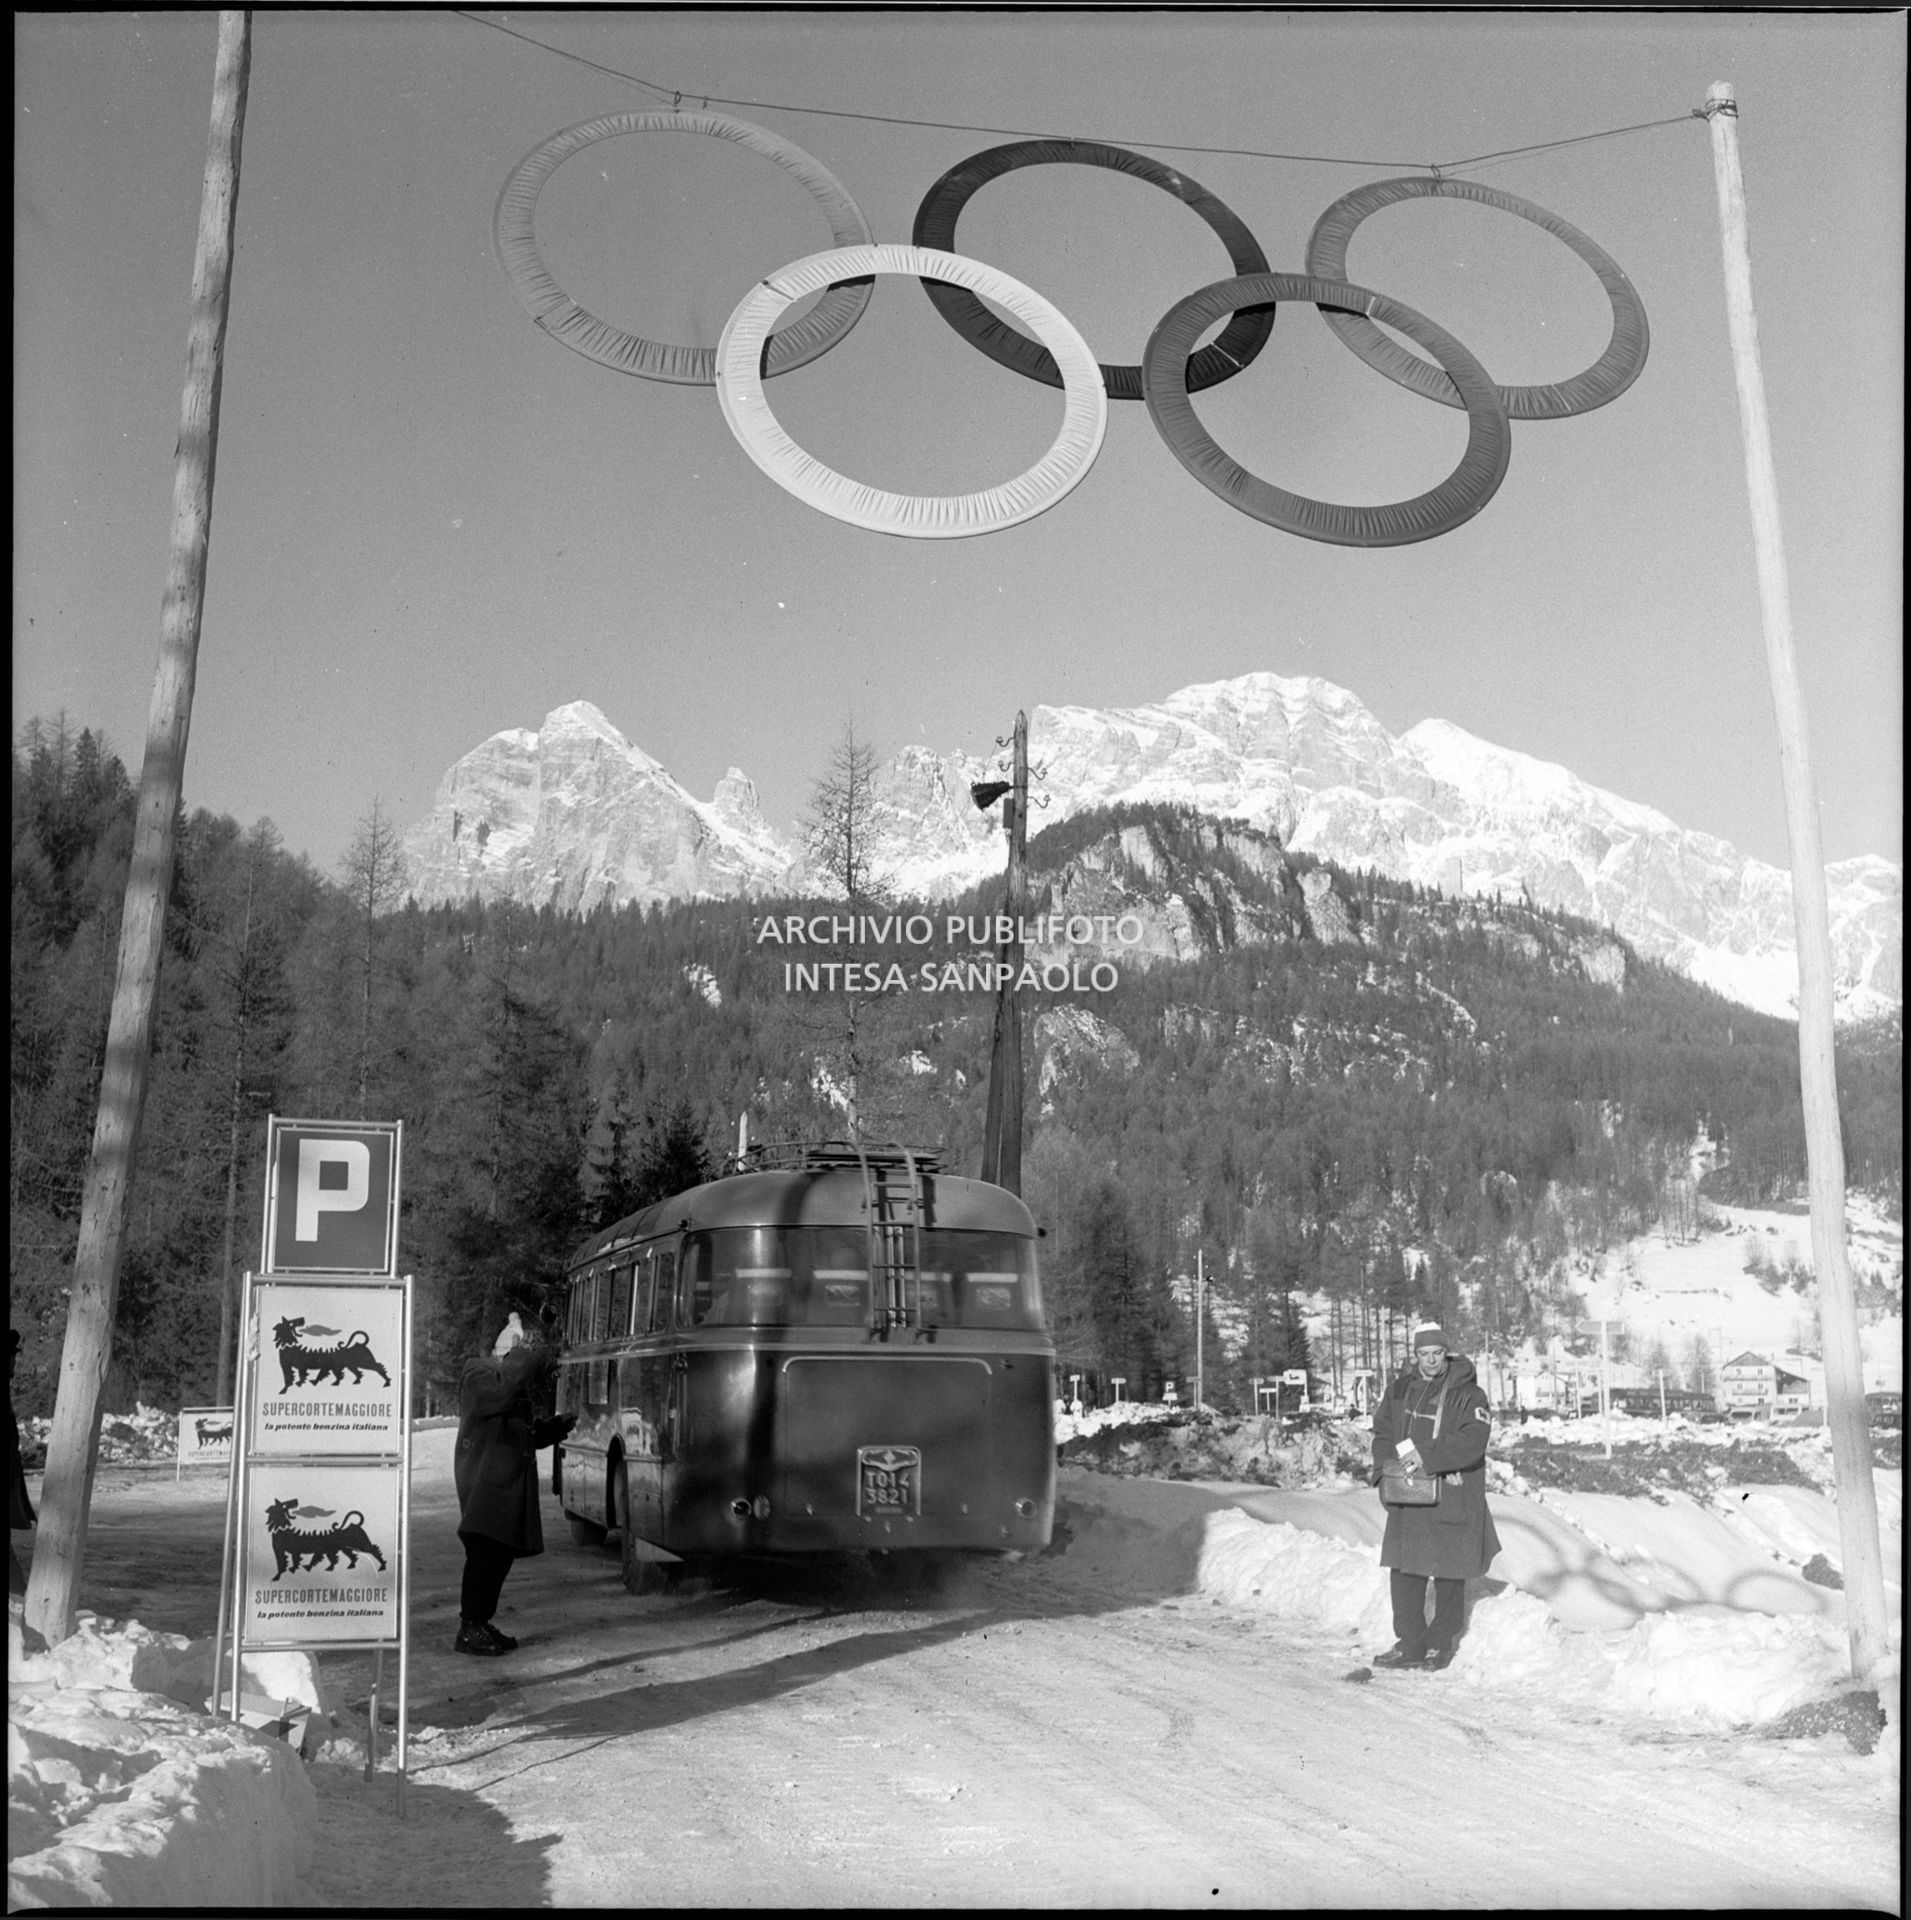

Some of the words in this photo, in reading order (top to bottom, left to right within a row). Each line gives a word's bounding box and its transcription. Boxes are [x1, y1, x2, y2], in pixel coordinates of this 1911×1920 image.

[296, 1139, 370, 1242] P
[1165, 1381, 1174, 1393] P
[262, 1402, 392, 1418] SUPERCORTEMAGGIORE
[264, 1423, 274, 1431] la
[275, 1423, 312, 1432] potente
[313, 1423, 350, 1431] benzina
[352, 1423, 389, 1431] italiana
[865, 1487, 908, 1505] 3821
[255, 1587, 388, 1605] SUPERCORTEMAGGIORE
[257, 1611, 267, 1619] la
[267, 1611, 306, 1620] potente
[306, 1609, 345, 1618] benzina
[346, 1608, 384, 1617] italiana
